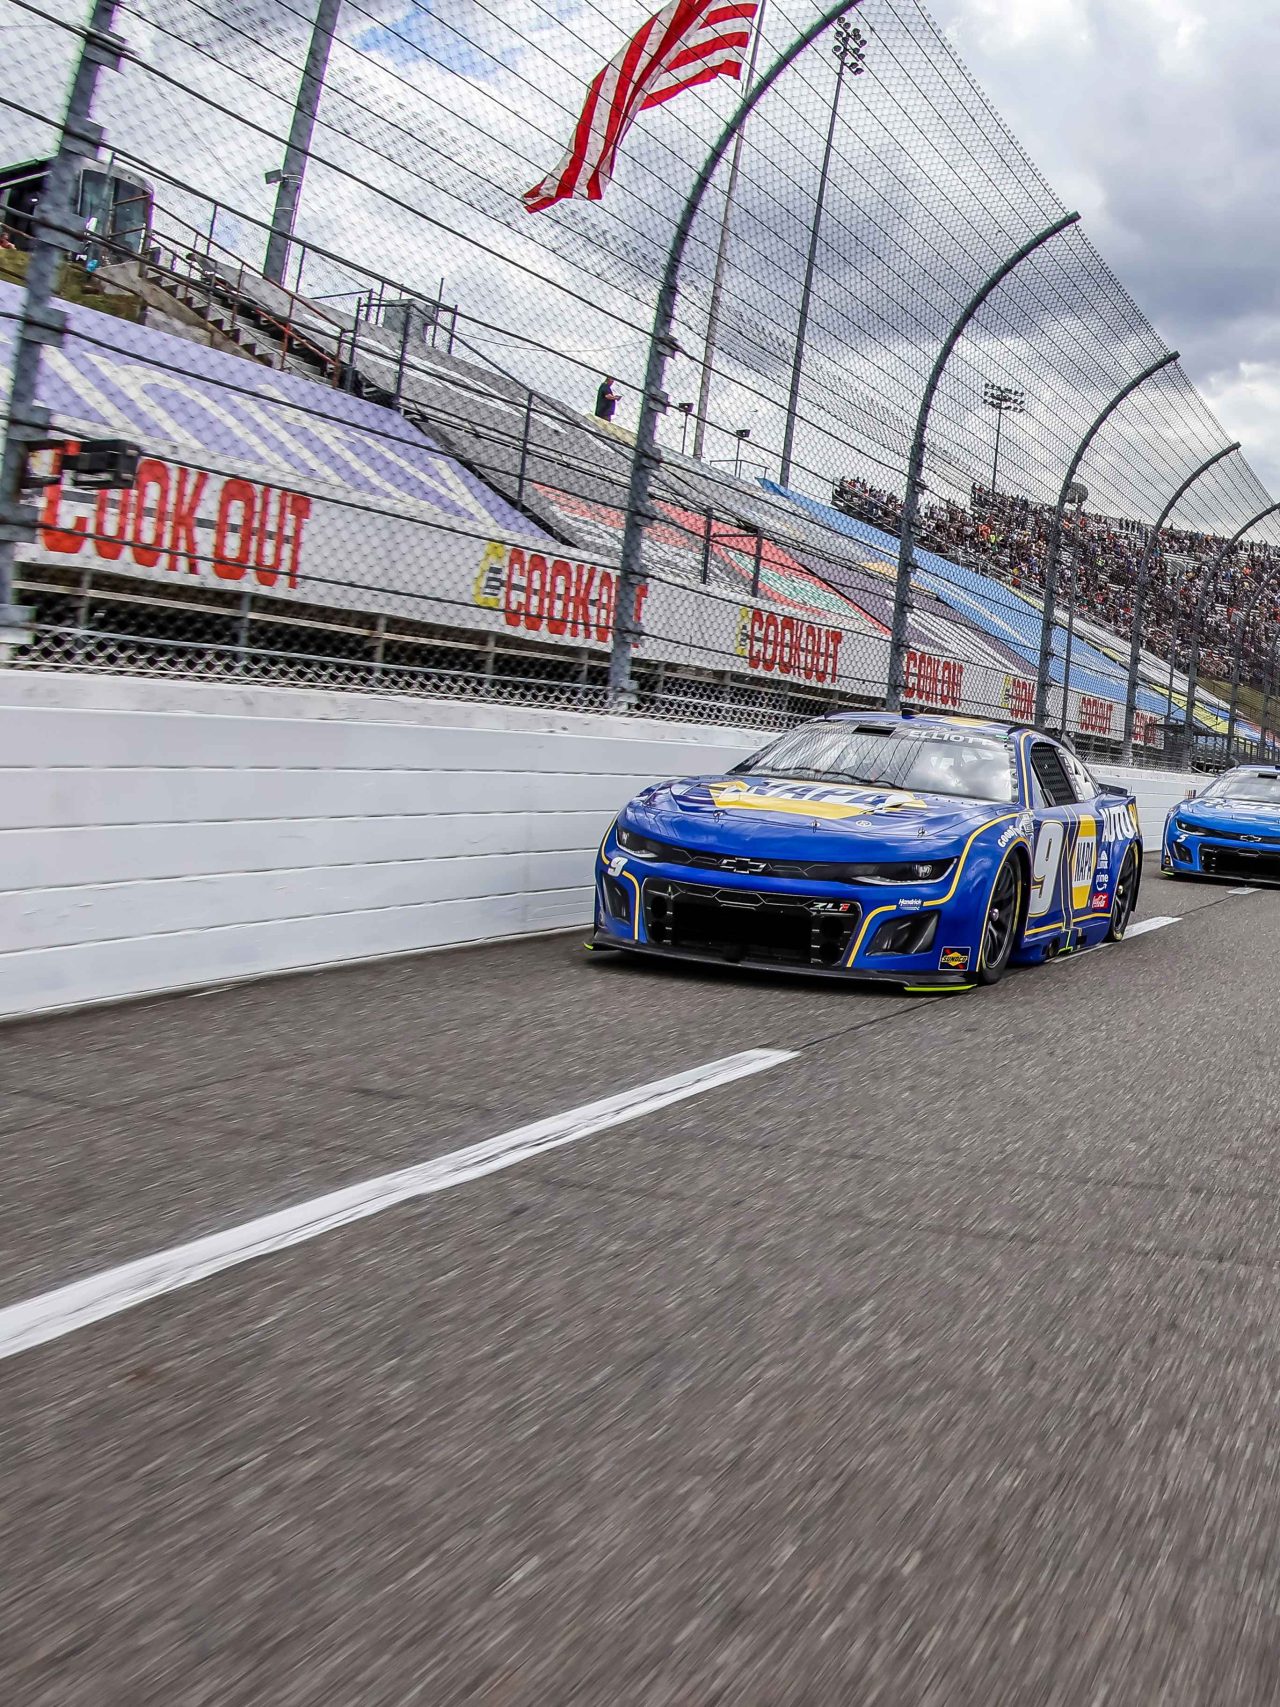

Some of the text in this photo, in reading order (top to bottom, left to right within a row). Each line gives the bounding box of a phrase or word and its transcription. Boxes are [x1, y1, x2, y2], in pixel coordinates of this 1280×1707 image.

[212, 477, 312, 590] OUT
[504, 546, 649, 649] COOK OT
[748, 608, 804, 677] COOK
[804, 624, 842, 684] OUT
[904, 651, 941, 705] COOK
[908, 729, 999, 747] ELLIOTT
[1099, 805, 1137, 843] AUTO
[1176, 834, 1189, 843] 5
[607, 856, 629, 877] 9
[1028, 819, 1065, 919] 9
[1074, 840, 1094, 883] NAPA
[1095, 872, 1109, 884] prime
[810, 901, 851, 912] ZL1
[942, 955, 968, 963] SUNOCO
